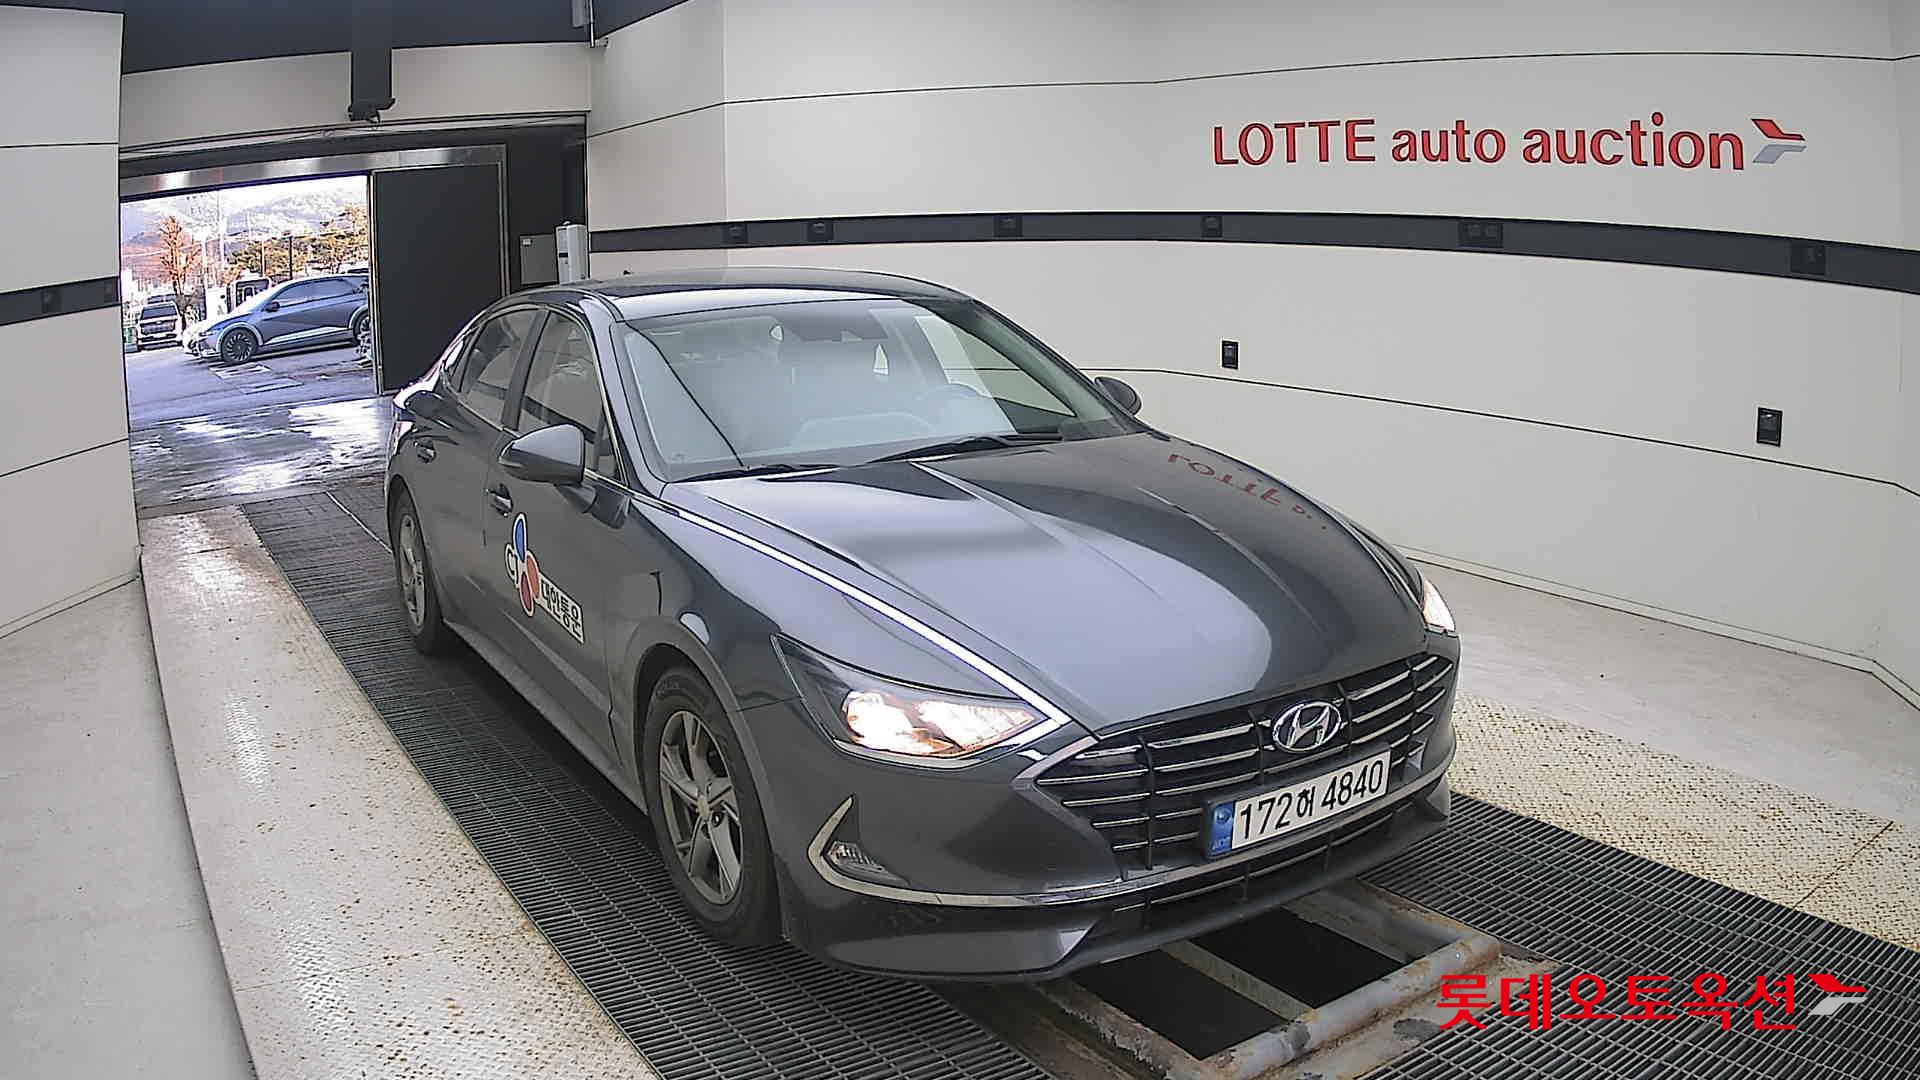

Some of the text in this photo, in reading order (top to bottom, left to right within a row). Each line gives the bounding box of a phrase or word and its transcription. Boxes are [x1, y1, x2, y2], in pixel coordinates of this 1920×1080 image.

[1213, 111, 1745, 171] LOTTE auto auction
[1239, 760, 1384, 839] 172허 4840
